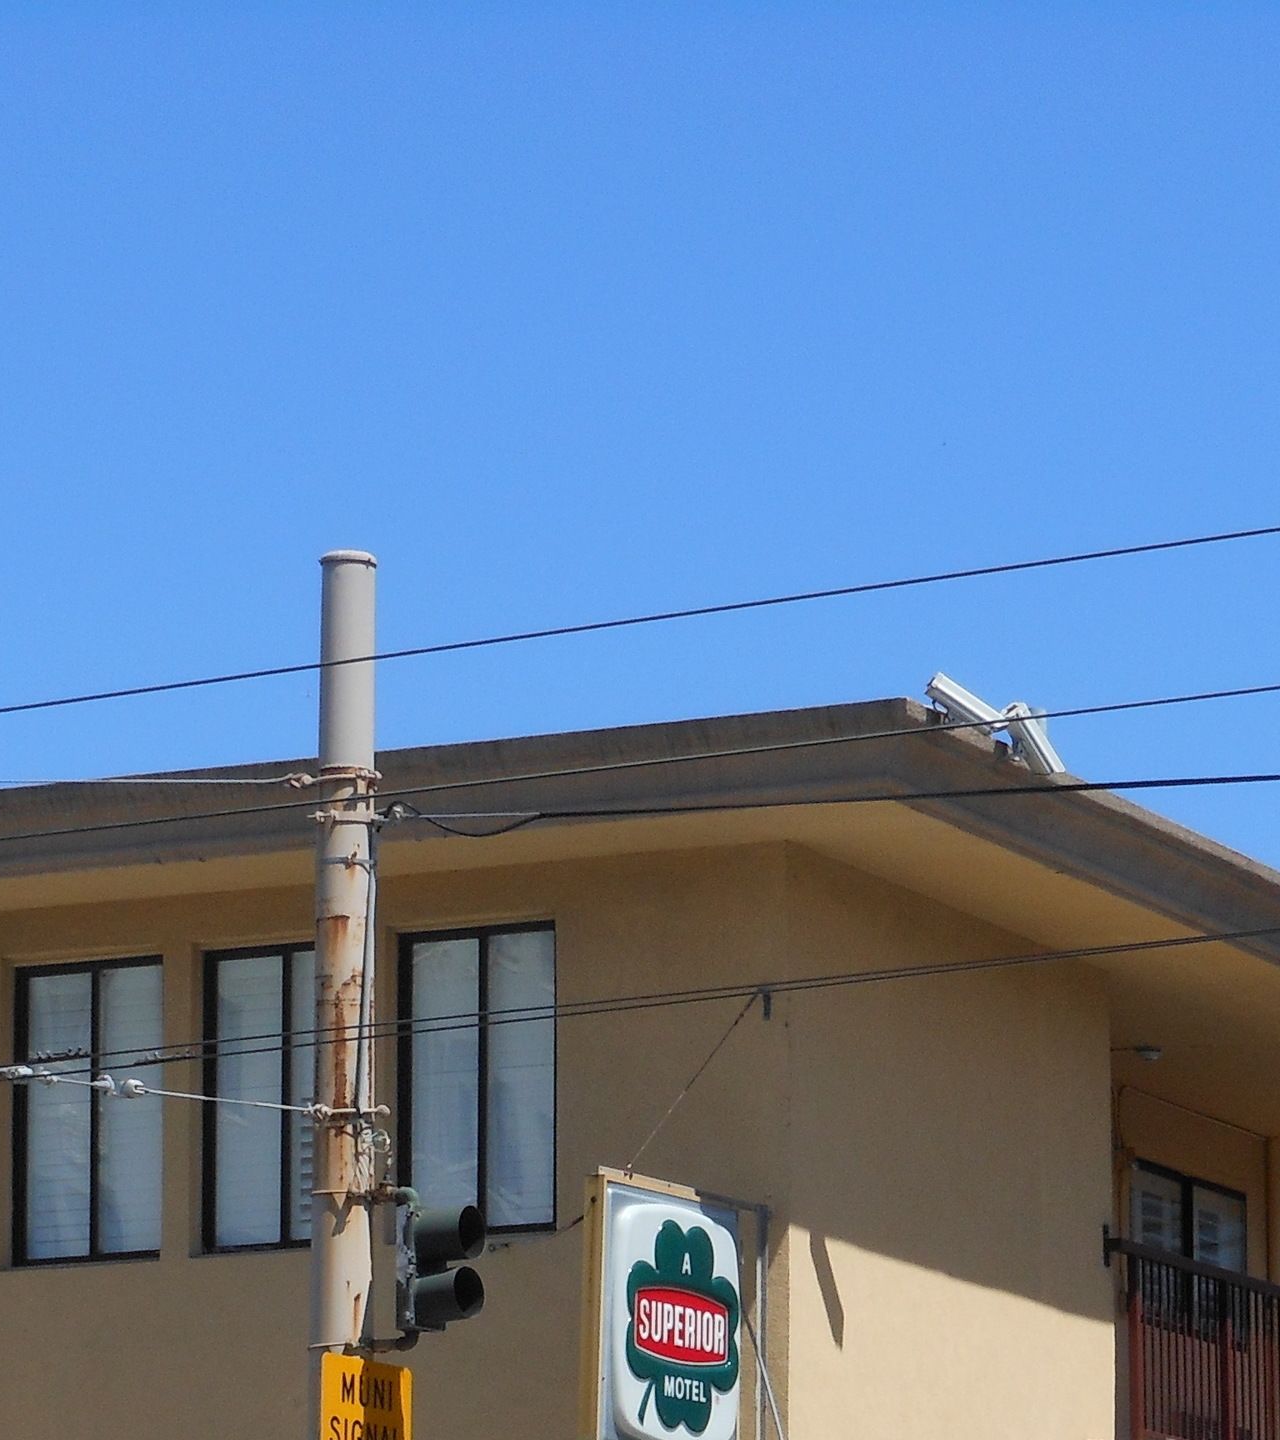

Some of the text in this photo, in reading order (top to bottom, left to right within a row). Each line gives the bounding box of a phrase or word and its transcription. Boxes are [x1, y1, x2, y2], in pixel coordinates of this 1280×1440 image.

[681, 1252, 692, 1275] A
[639, 1298, 725, 1355] SUPERIOR
[342, 1371, 392, 1412] MUNI
[664, 1375, 707, 1403] MOTEL
